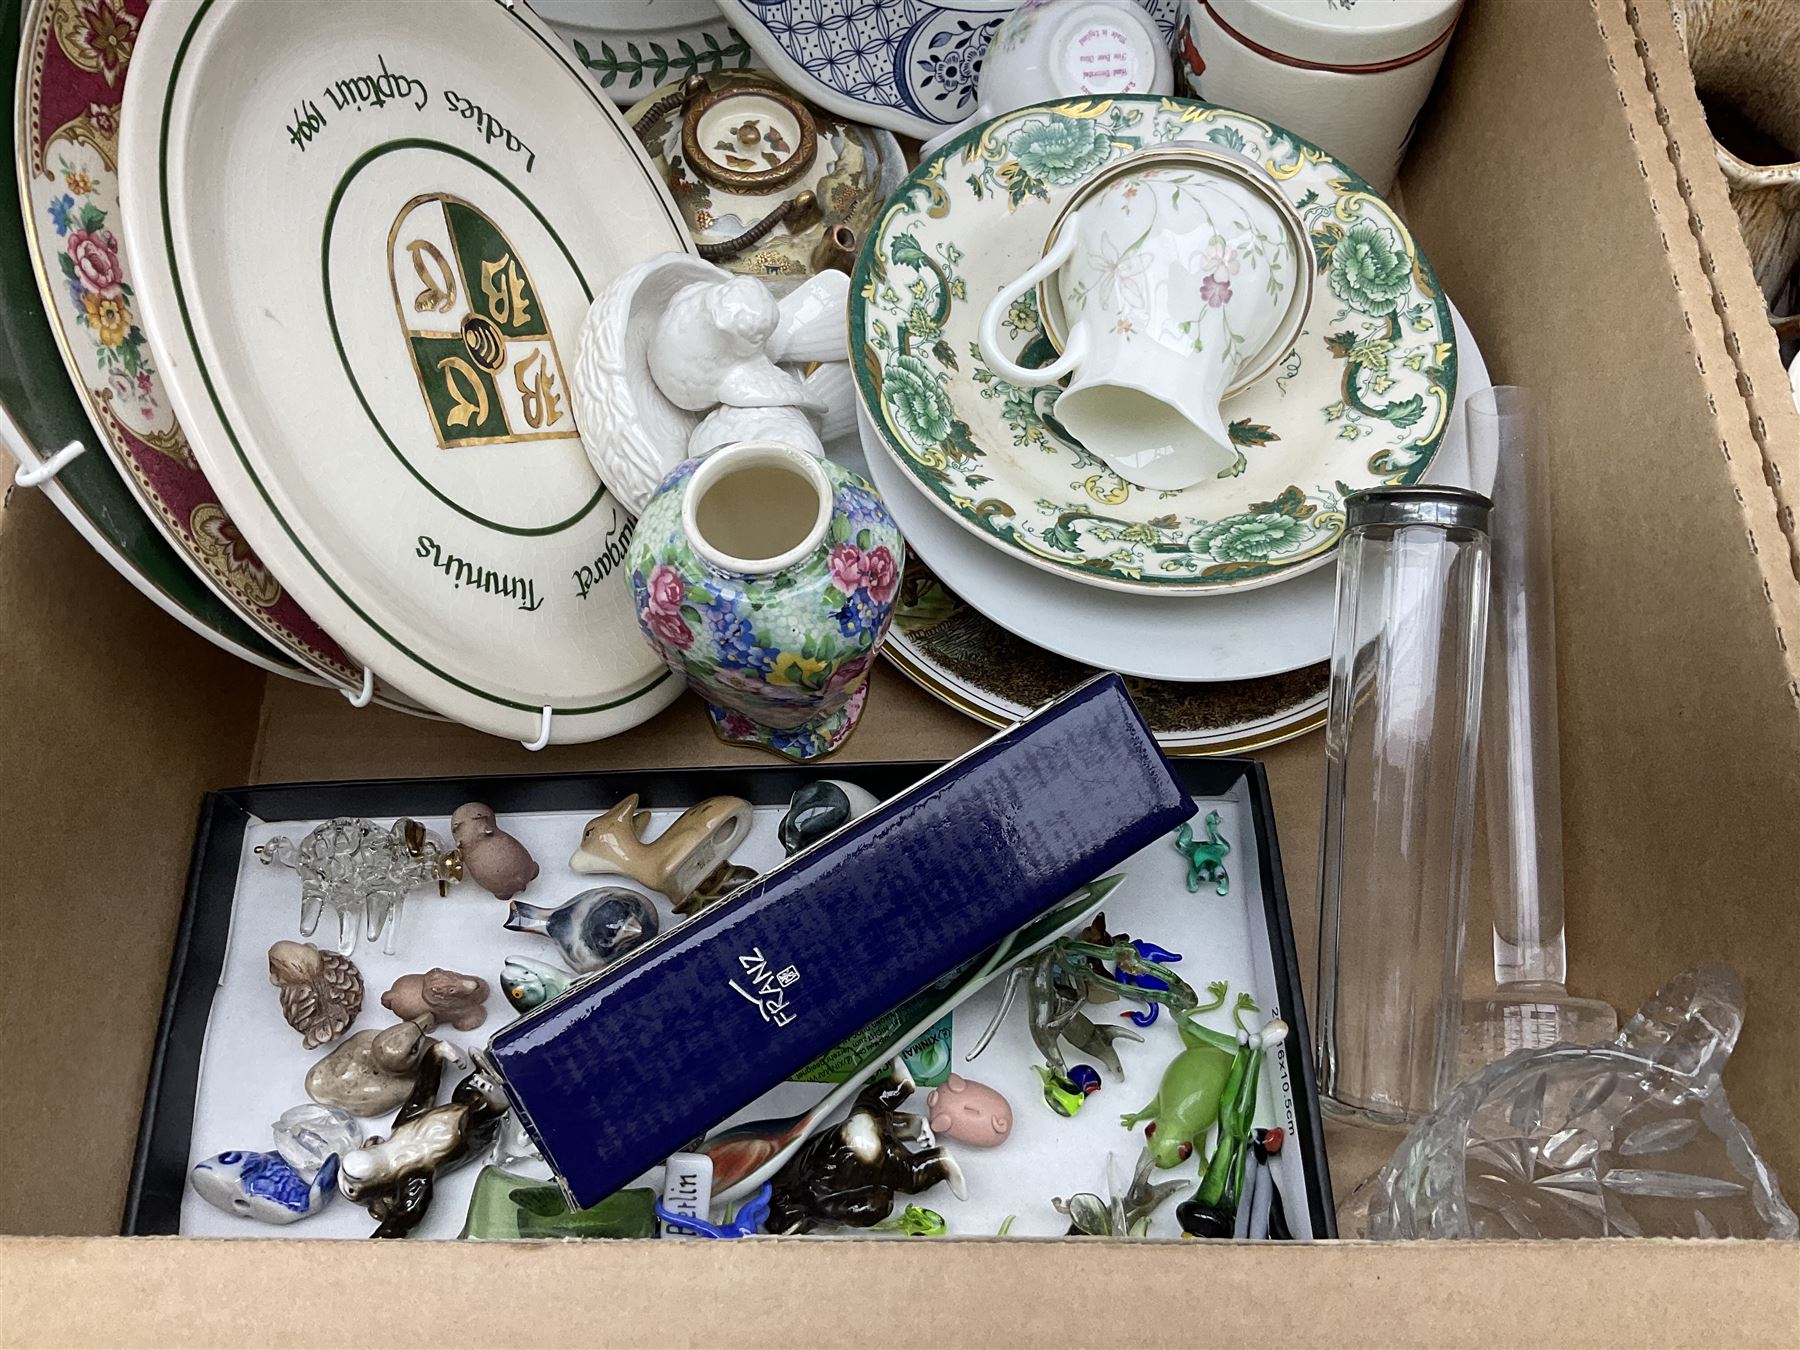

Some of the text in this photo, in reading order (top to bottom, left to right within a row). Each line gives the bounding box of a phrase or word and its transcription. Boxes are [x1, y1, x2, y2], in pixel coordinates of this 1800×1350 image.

[1079, 30, 1100, 46] England
[1111, 31, 1126, 44] Made
[286, 54, 536, 173] Ladies Captain 1994
[415, 508, 639, 611] argaret Timmins
[738, 947, 798, 1027] FRANZ
